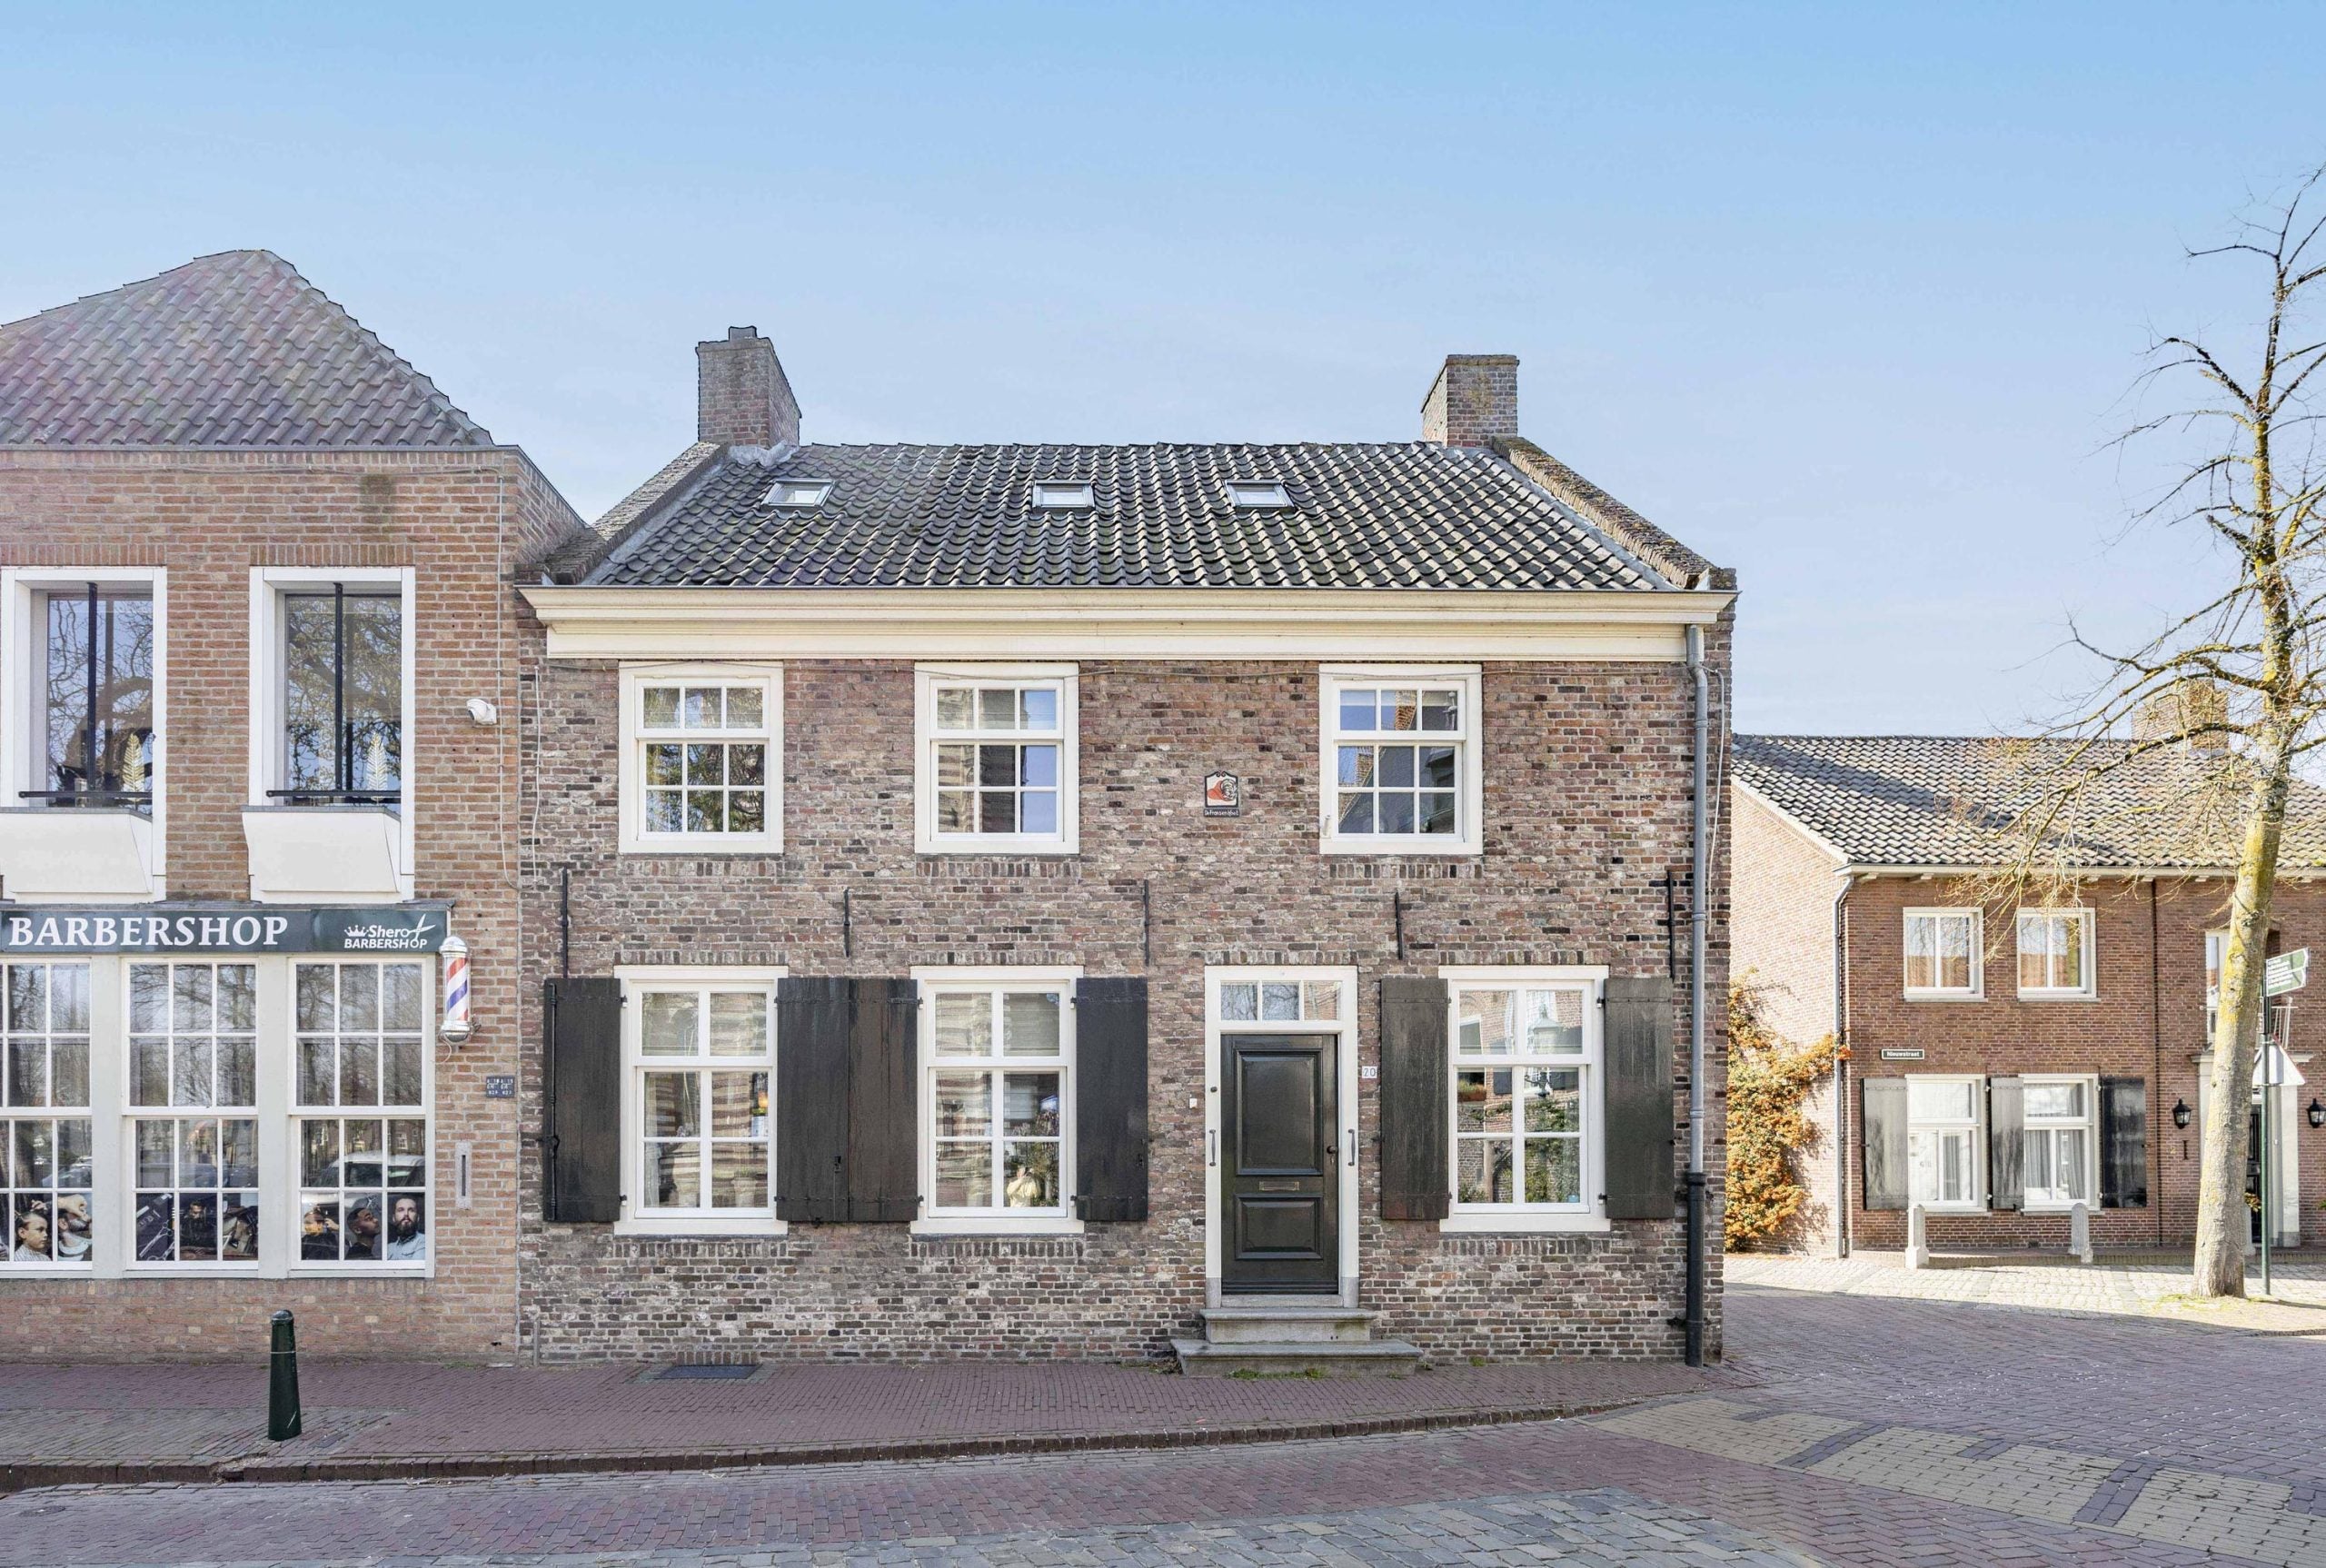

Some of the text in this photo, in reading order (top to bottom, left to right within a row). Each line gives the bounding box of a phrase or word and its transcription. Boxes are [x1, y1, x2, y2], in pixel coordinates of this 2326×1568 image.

[8, 916, 288, 947] BARBERSHOP
[368, 924, 410, 938] Shero
[343, 938, 428, 949] BARBERSHOP
[1364, 1067, 1377, 1077] 20
